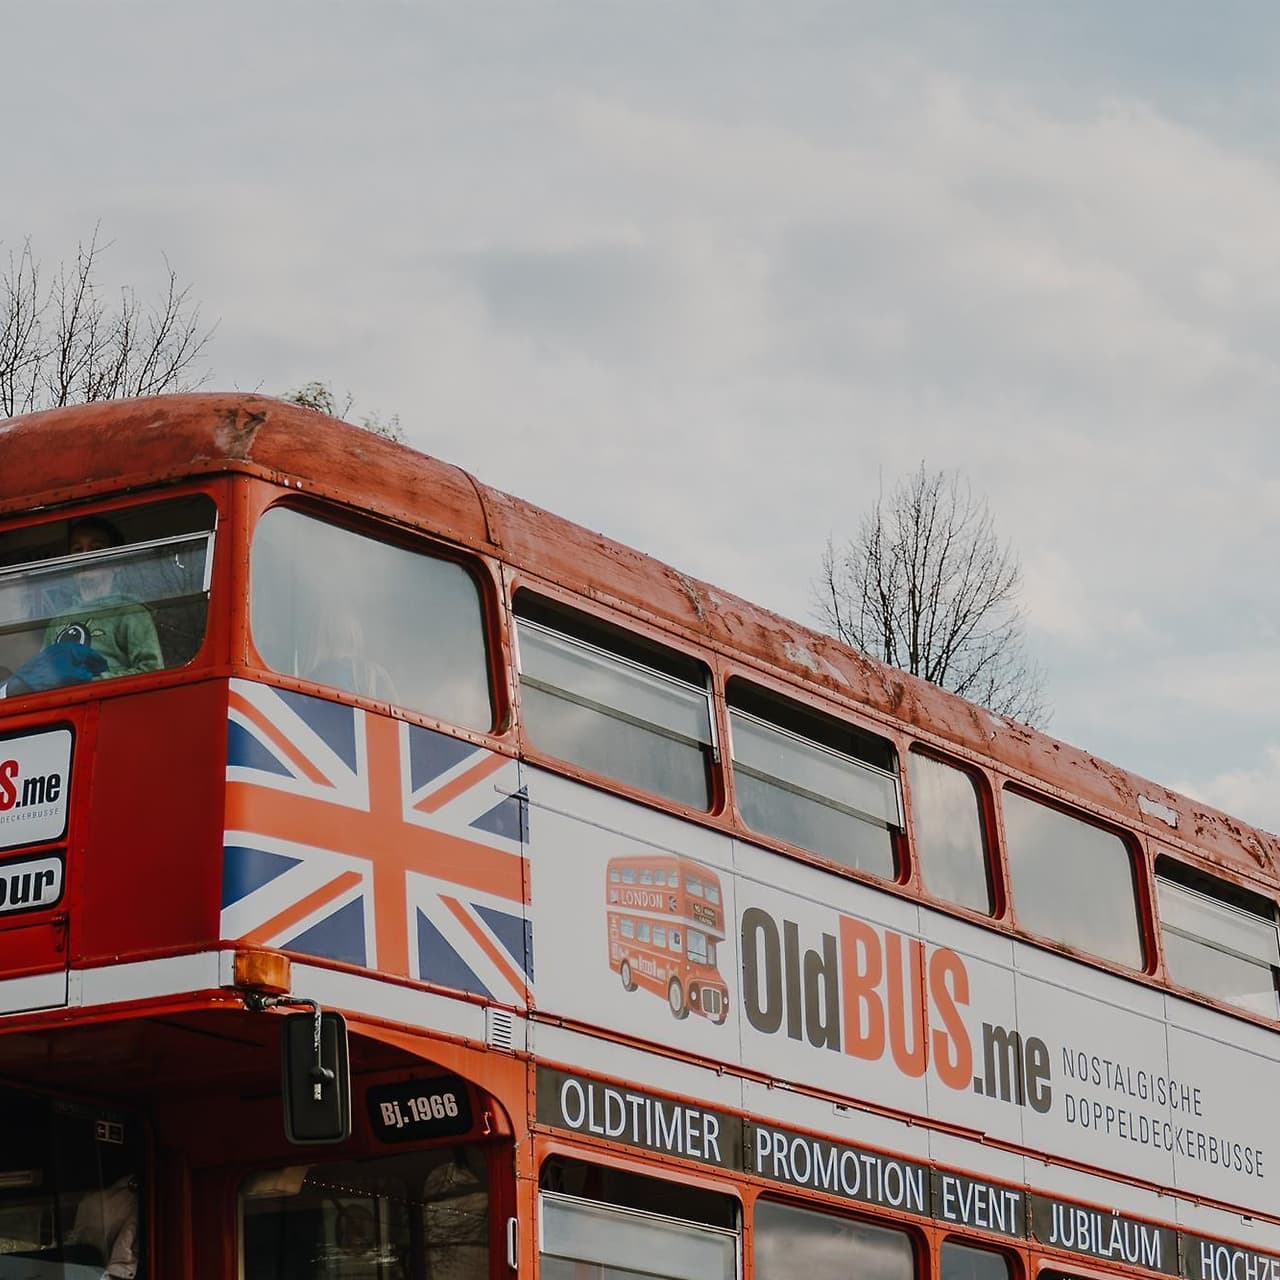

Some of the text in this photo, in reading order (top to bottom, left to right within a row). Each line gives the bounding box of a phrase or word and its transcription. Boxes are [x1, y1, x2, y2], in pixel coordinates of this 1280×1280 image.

[622, 889, 663, 909] LONDON
[741, 907, 1052, 1114] OldBUS.me
[560, 1078, 722, 1162] OLDTIMER
[1063, 1047, 1203, 1117] NOSTALGISCHE
[756, 1128, 924, 1212] PROMOTION
[1065, 1093, 1265, 1178] DOPPELDECKERBUSSE
[942, 1176, 1020, 1234] EVENT
[1049, 1203, 1162, 1269] JUBILÄUM
